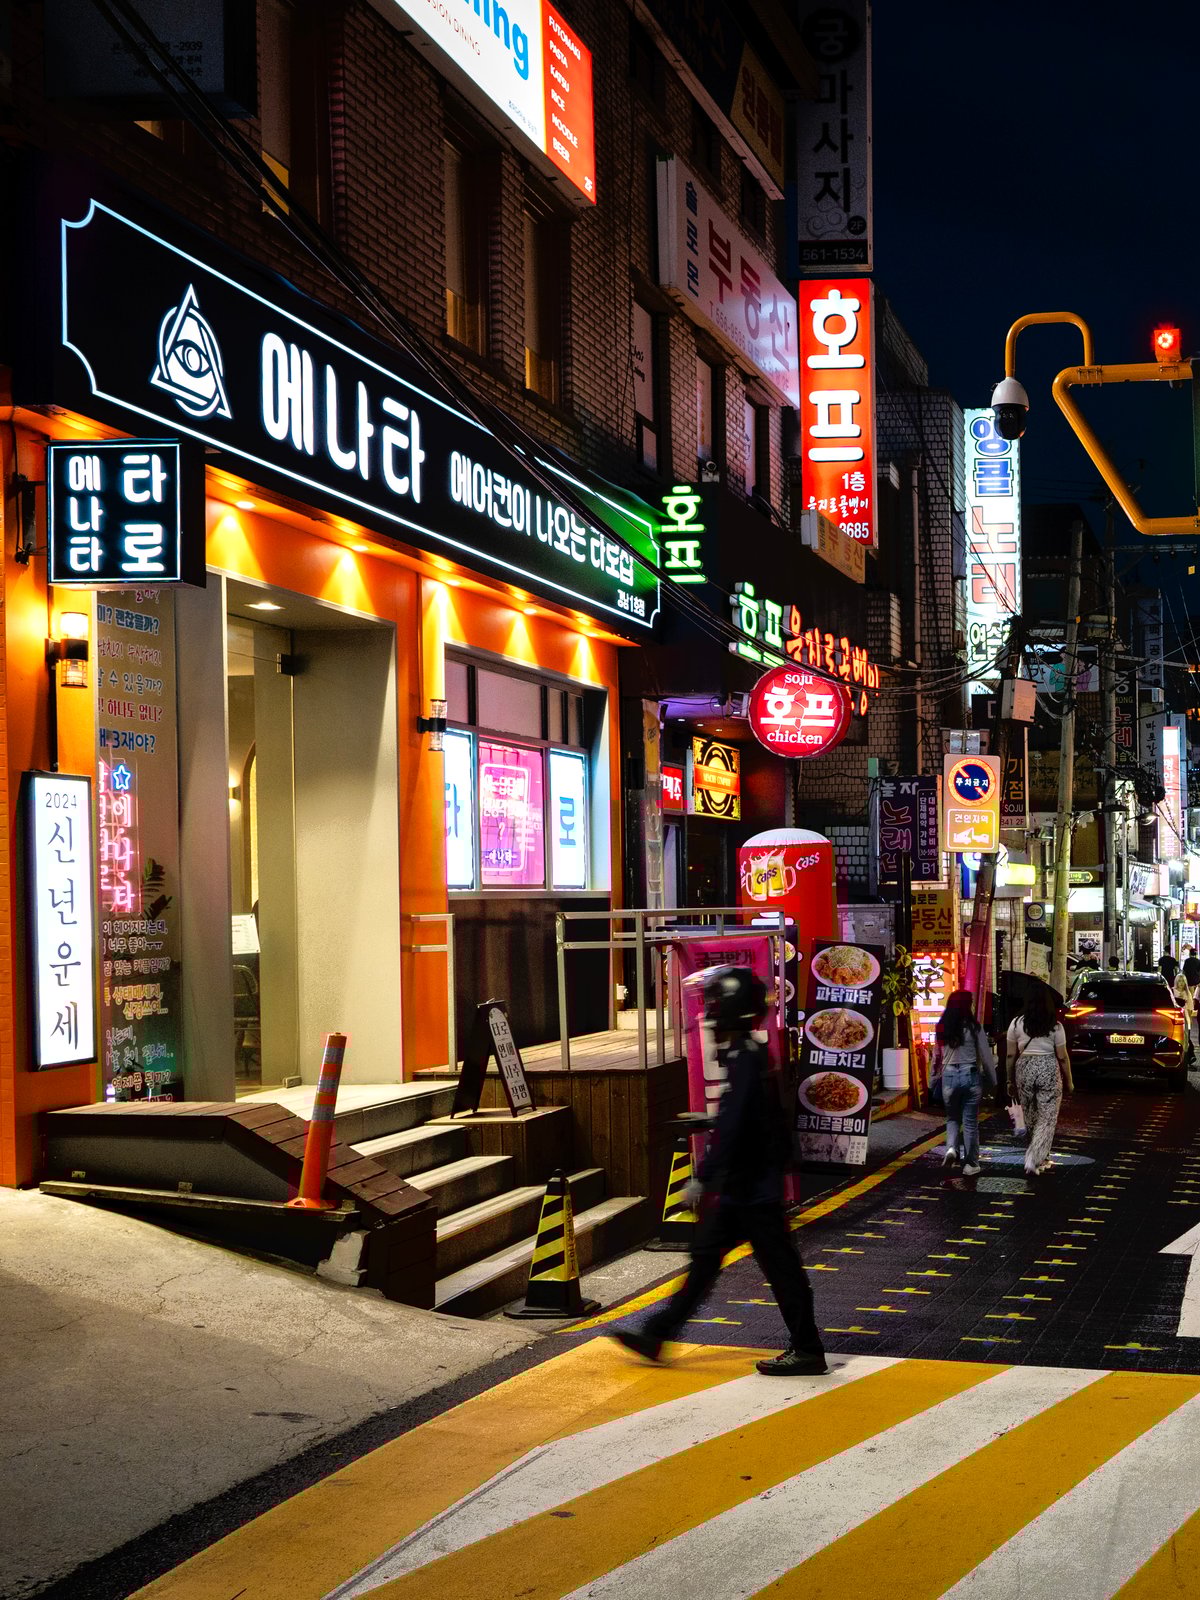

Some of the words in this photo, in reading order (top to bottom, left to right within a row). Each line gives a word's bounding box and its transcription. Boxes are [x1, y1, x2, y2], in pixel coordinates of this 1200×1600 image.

[454, 19, 481, 55] DINING
[549, 16, 581, 60] FUTOMAKI
[550, 40, 568, 68] PASTA
[550, 65, 569, 92] KATSU
[551, 89, 566, 111] RICE
[552, 113, 579, 148] NOODLE
[813, 70, 854, 213] 마사지
[553, 137, 570, 163] BEER
[709, 218, 790, 372] 부동산
[806, 289, 866, 462] 호프
[262, 332, 425, 504] 에나타
[842, 472, 866, 491] 1층
[69, 455, 104, 572] 에나타
[121, 454, 167, 572] 타로
[450, 451, 531, 537] 에어컨이
[536, 495, 586, 562] 나오는
[807, 495, 869, 518] 을지로골뱅이
[661, 485, 708, 583] 호프
[115, 608, 159, 635] 괜찮을까?
[738, 582, 786, 669] 호프
[970, 622, 1011, 662] 연습
[110, 670, 118, 688] 수
[123, 673, 163, 697] 있을까?
[785, 674, 813, 684] soju
[108, 699, 135, 719] 하나도
[138, 704, 163, 722] 없니?
[760, 686, 836, 727] 호프
[112, 730, 156, 754] 3재야?
[767, 729, 823, 744] chicken
[45, 792, 77, 809] 2024
[880, 779, 919, 797] 놀자
[559, 796, 576, 846] 로
[1005, 804, 1024, 812] SOJU
[112, 793, 134, 909] 에나타
[796, 852, 820, 871] Cass
[757, 867, 778, 884] Cass
[921, 862, 936, 874] B1
[113, 920, 168, 936] 헤어지라는데,
[911, 907, 953, 931] 부동산
[47, 816, 82, 1050] 신년운세
[109, 937, 127, 951] 너무
[114, 959, 132, 976] 맞는
[134, 957, 171, 975] 커플일까?
[816, 986, 873, 1005] 파닭파닭
[809, 1050, 866, 1069] 마늘치킨
[797, 1114, 866, 1134] 을지로골뱅이
